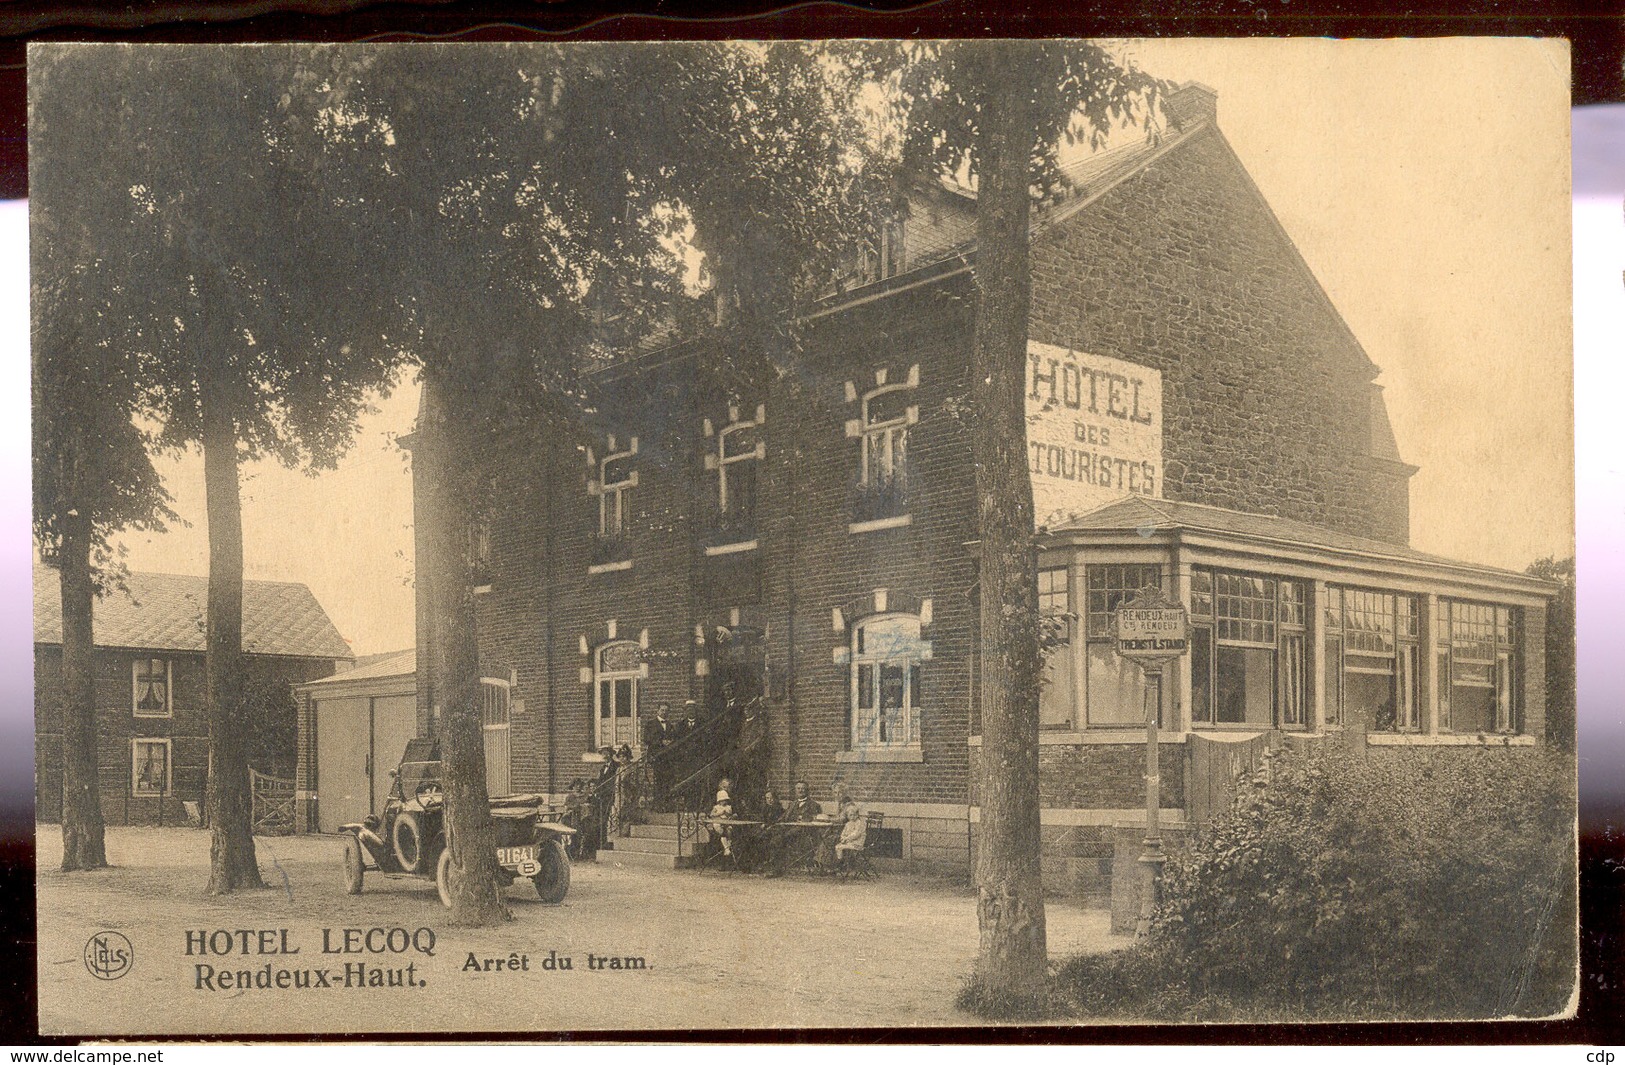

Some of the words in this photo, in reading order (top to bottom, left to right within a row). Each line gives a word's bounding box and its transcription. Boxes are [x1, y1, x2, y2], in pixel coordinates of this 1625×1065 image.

[1028, 349, 1152, 426] HÔTEL
[1073, 420, 1110, 447] DES
[1029, 440, 1155, 496] TOURISTES
